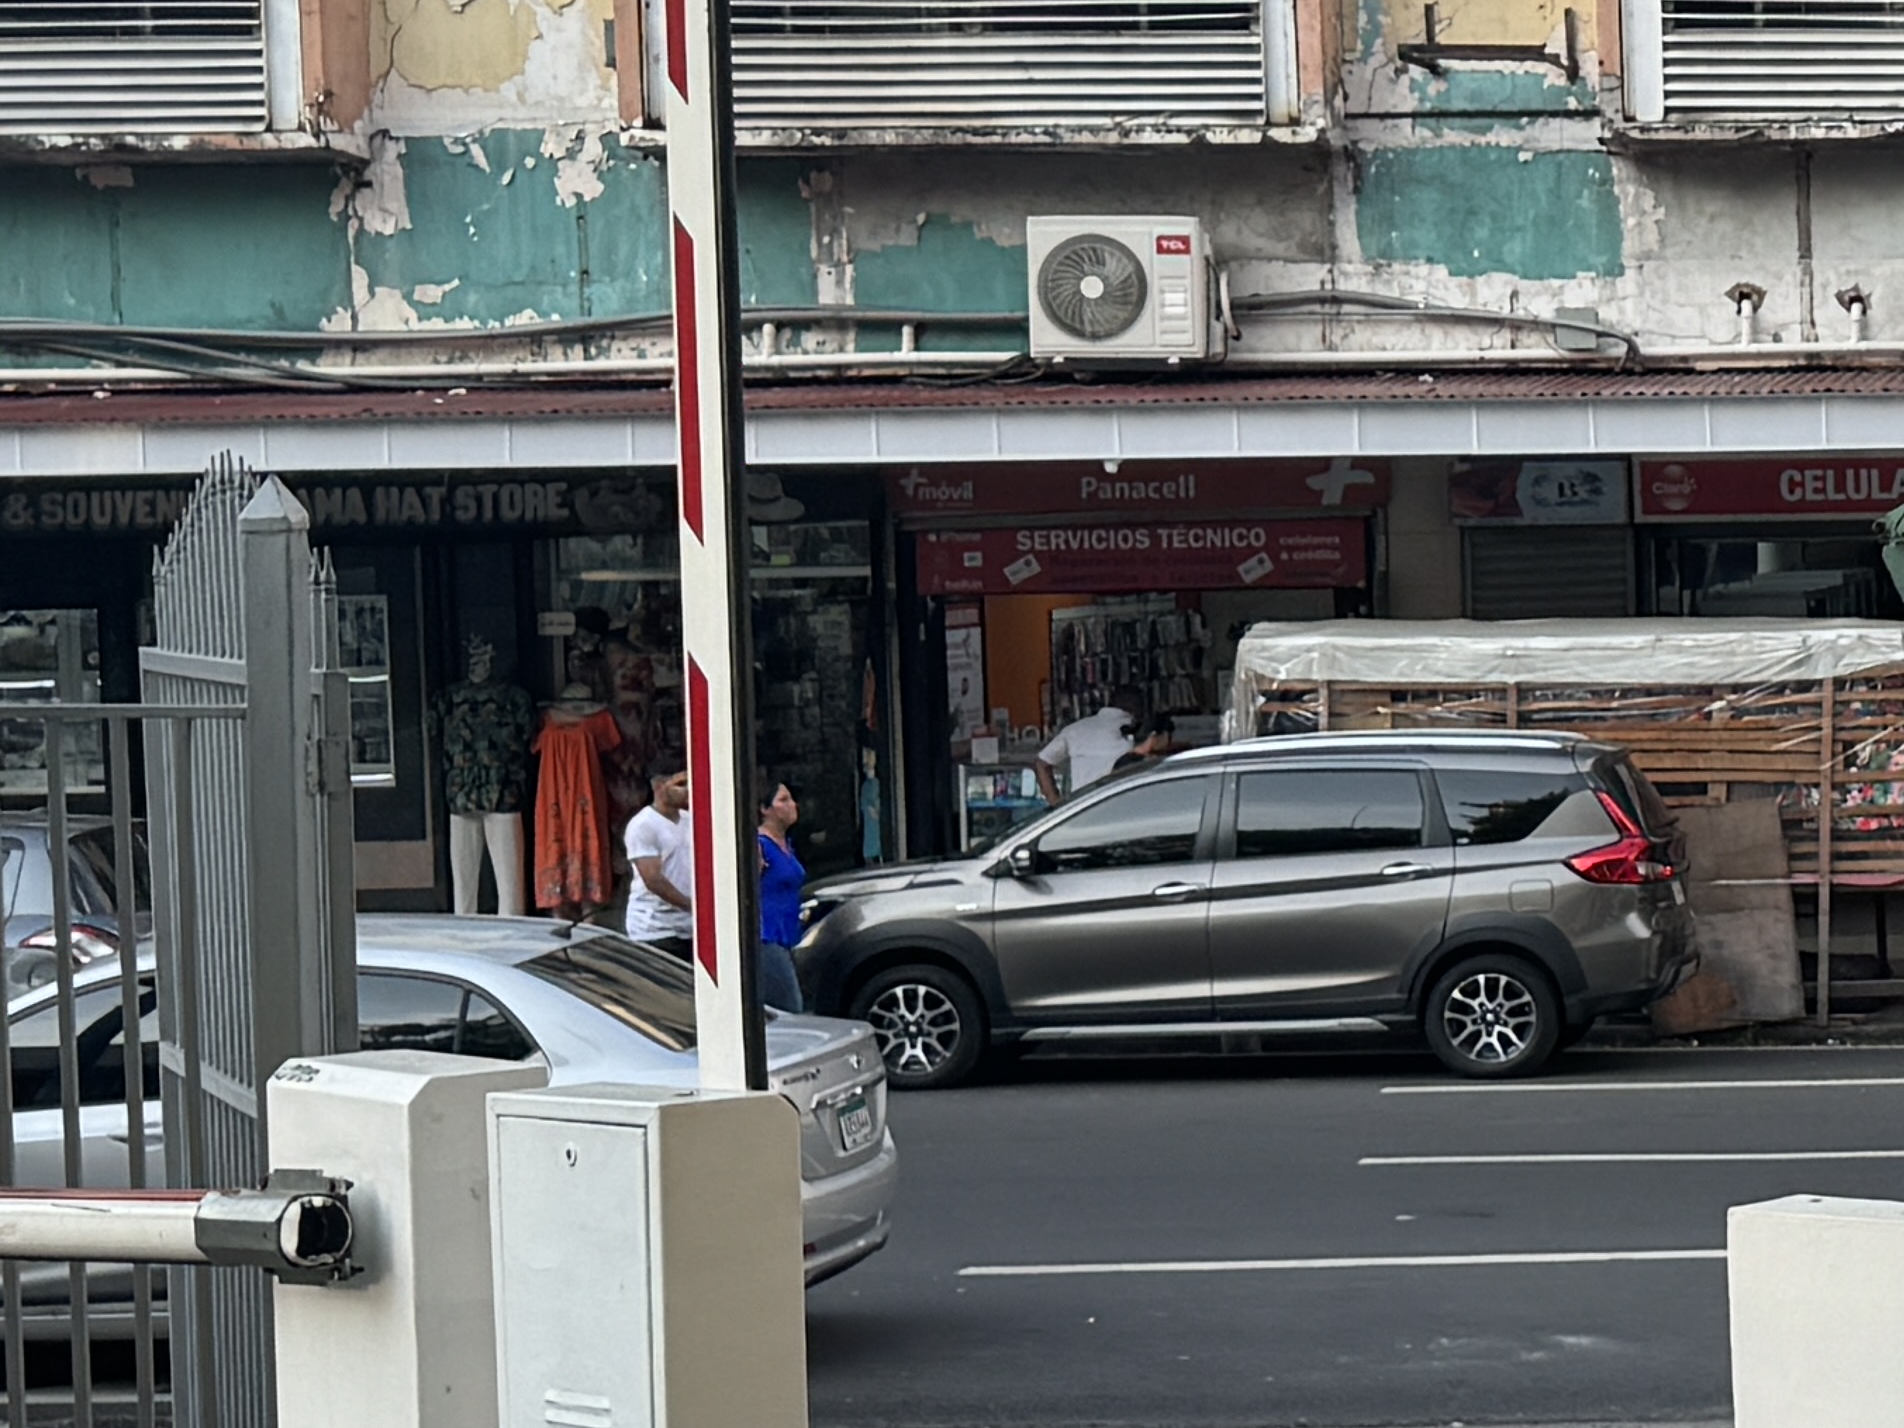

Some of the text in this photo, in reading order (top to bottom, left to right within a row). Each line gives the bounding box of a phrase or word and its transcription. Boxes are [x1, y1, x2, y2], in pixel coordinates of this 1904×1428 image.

[1080, 474, 1197, 500] Panacell
[374, 485, 446, 523] HAT
[454, 481, 571, 521] STORE
[1015, 523, 1267, 550] SERVICIOS TÉCNICO
